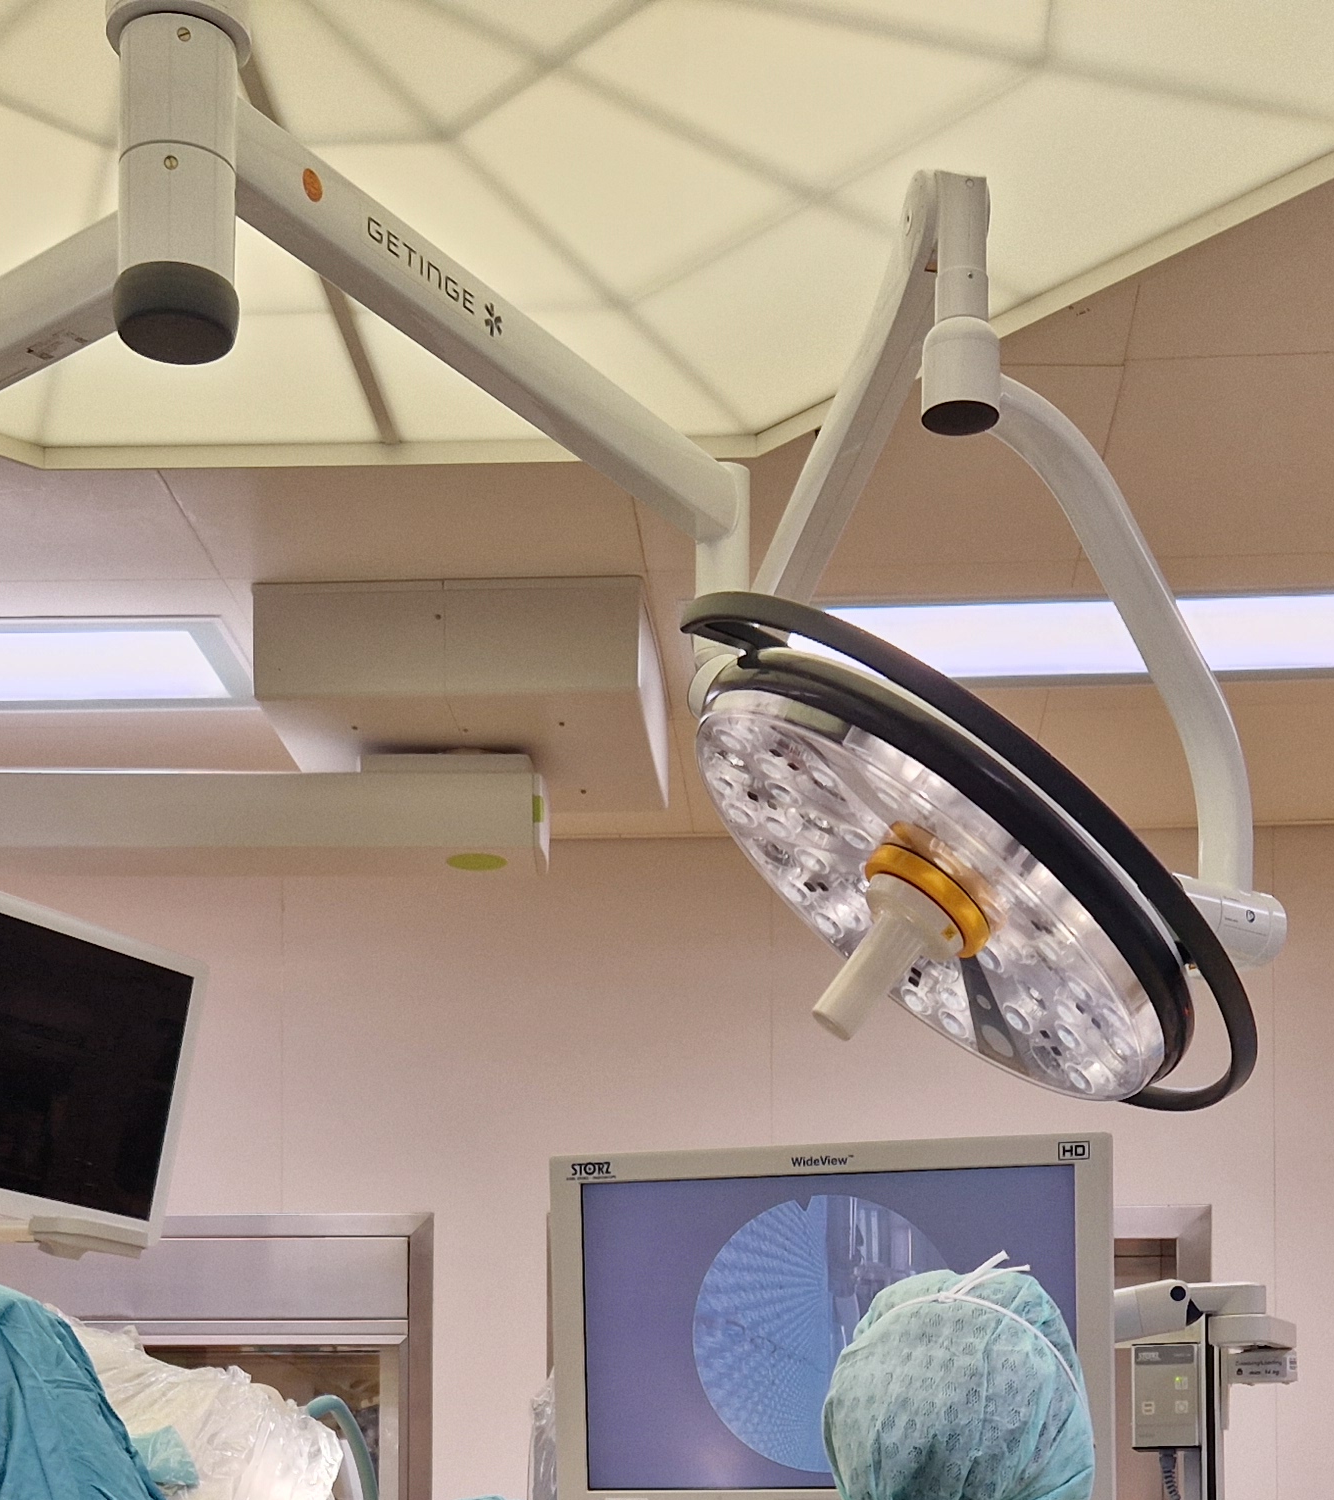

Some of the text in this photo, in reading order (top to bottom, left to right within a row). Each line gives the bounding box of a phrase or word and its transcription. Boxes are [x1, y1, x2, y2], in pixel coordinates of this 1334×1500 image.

[367, 216, 475, 315] GETINGE
[1062, 1145, 1086, 1157] HD
[571, 1161, 611, 1176] STORZ
